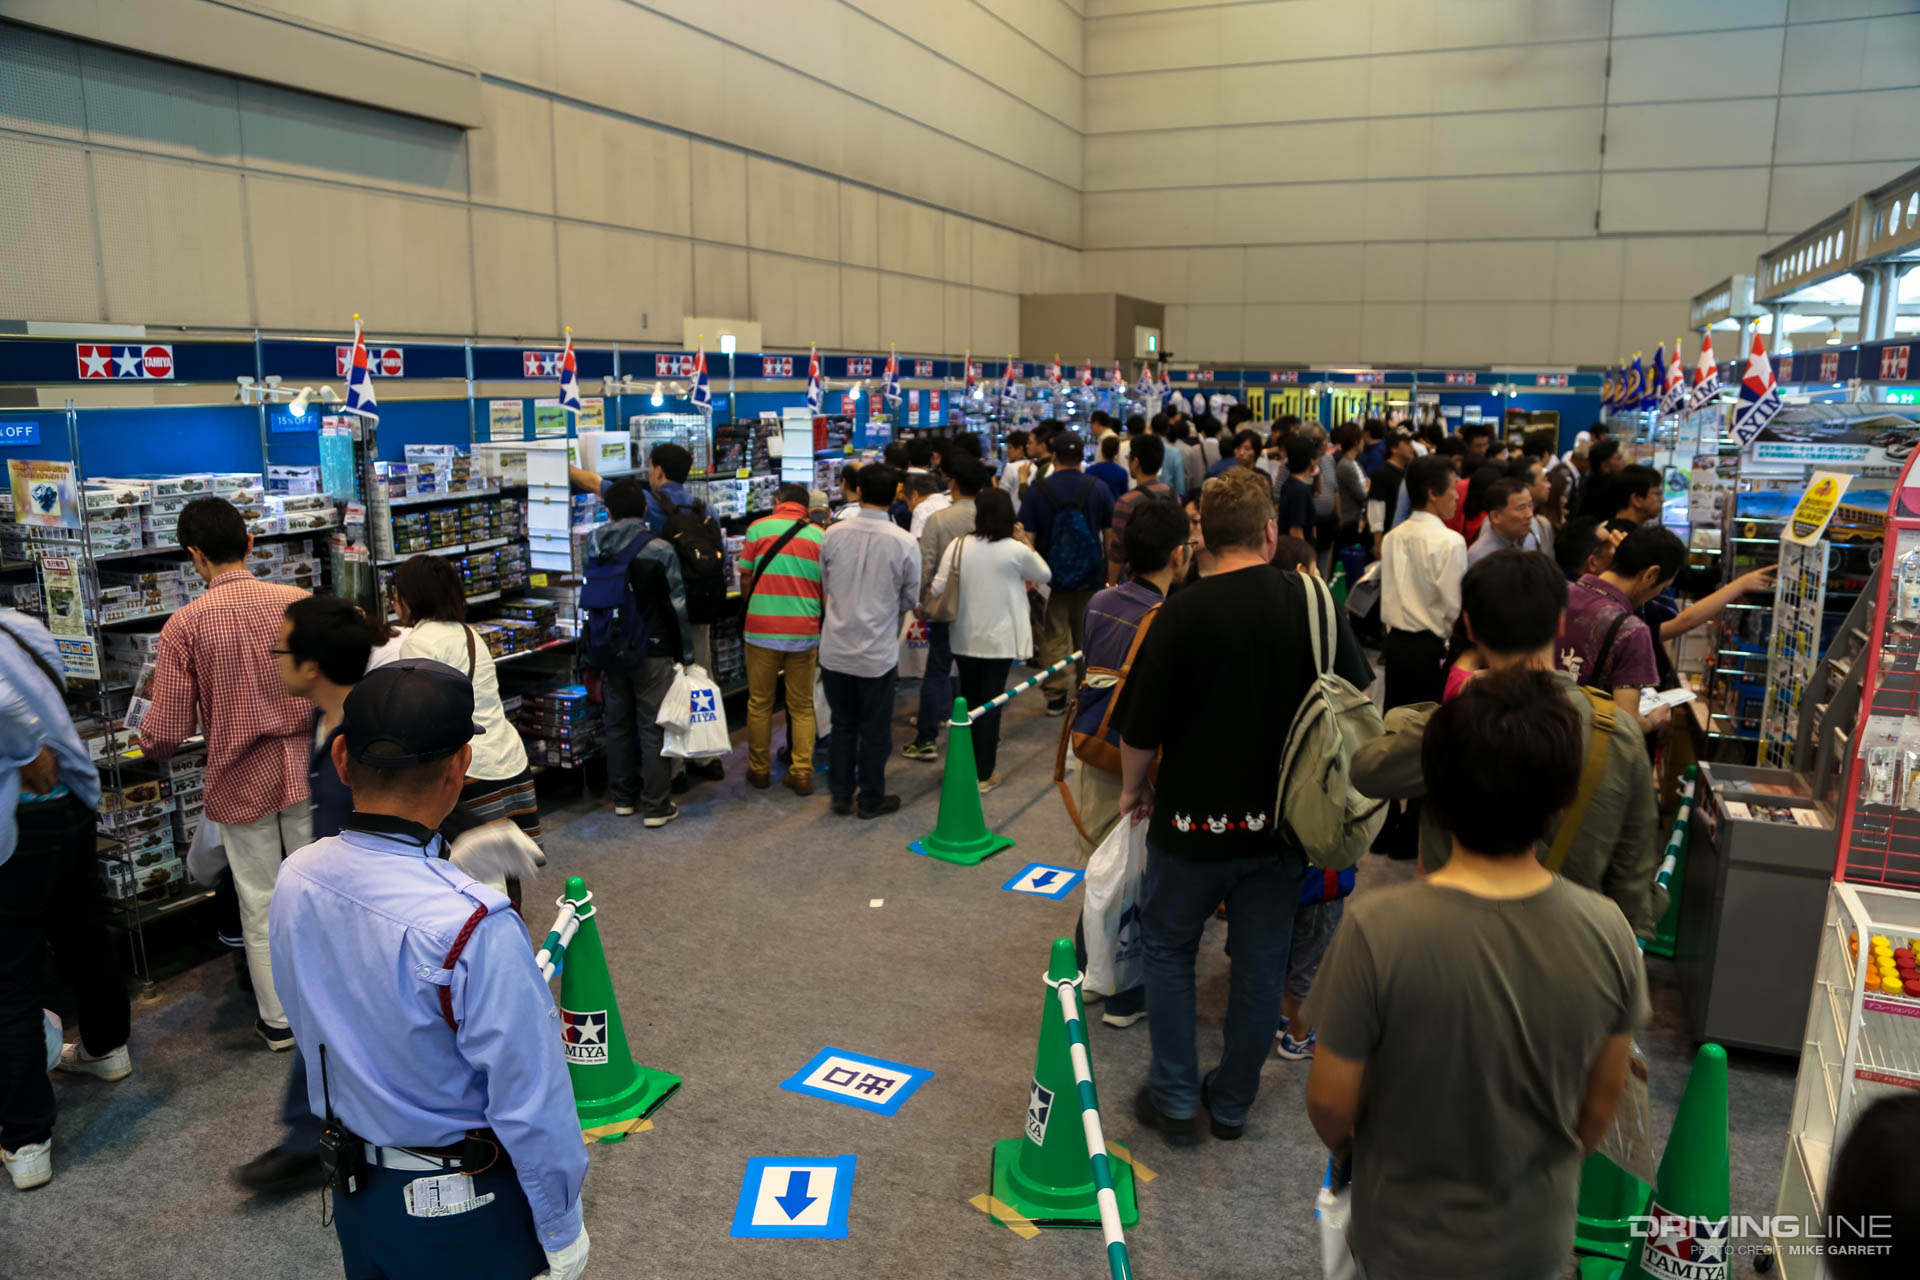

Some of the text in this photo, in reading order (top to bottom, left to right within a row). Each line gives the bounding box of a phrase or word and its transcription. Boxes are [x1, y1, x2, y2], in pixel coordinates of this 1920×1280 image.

[144, 356, 173, 368] TAMIYA
[564, 1043, 607, 1059] MIYA
[821, 1066, 896, 1096] 出口
[1644, 1245, 1726, 1280] TAMIYA
